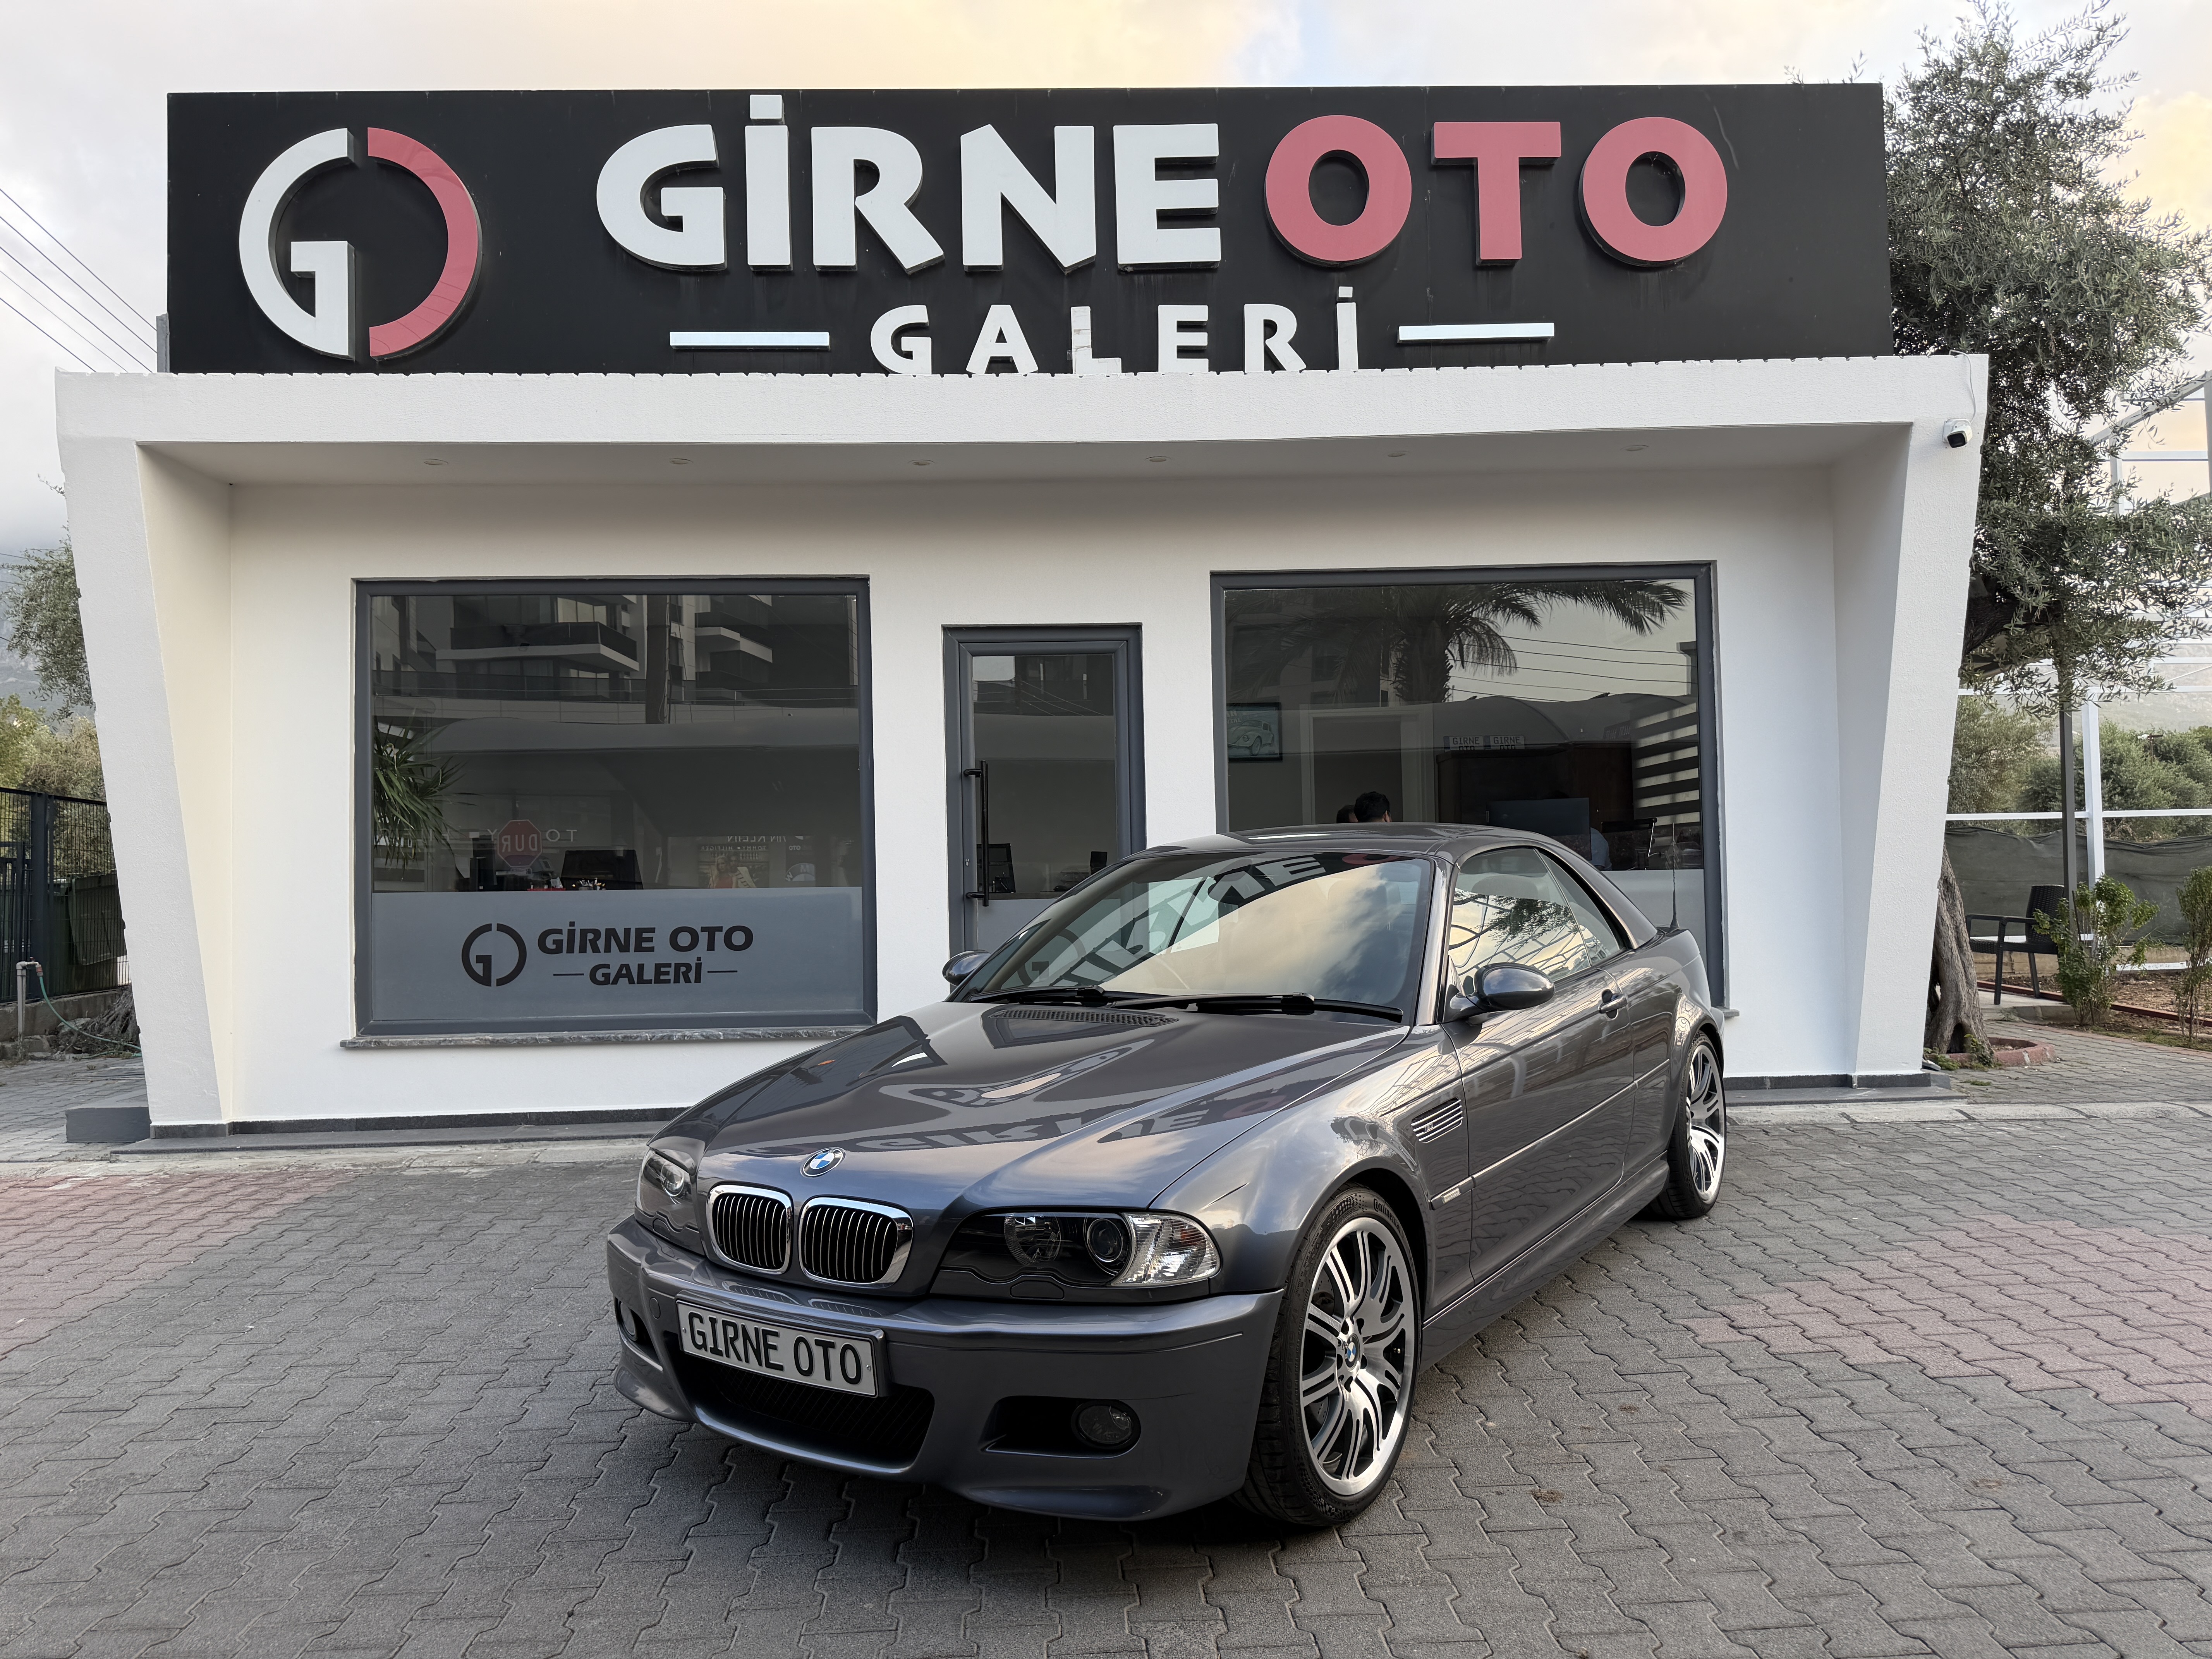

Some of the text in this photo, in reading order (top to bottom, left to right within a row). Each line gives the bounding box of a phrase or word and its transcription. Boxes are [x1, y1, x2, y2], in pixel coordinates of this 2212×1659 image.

[596, 94, 1729, 273] GİRNE OTO
[869, 286, 1358, 374] GALERİ
[1493, 736, 1521, 744] GIRNE
[537, 921, 754, 955] GİRNE OTO
[589, 957, 702, 986] GALERİ
[1373, 1198, 1401, 1233] Continental
[688, 1311, 862, 1385] GIRNE OTO
